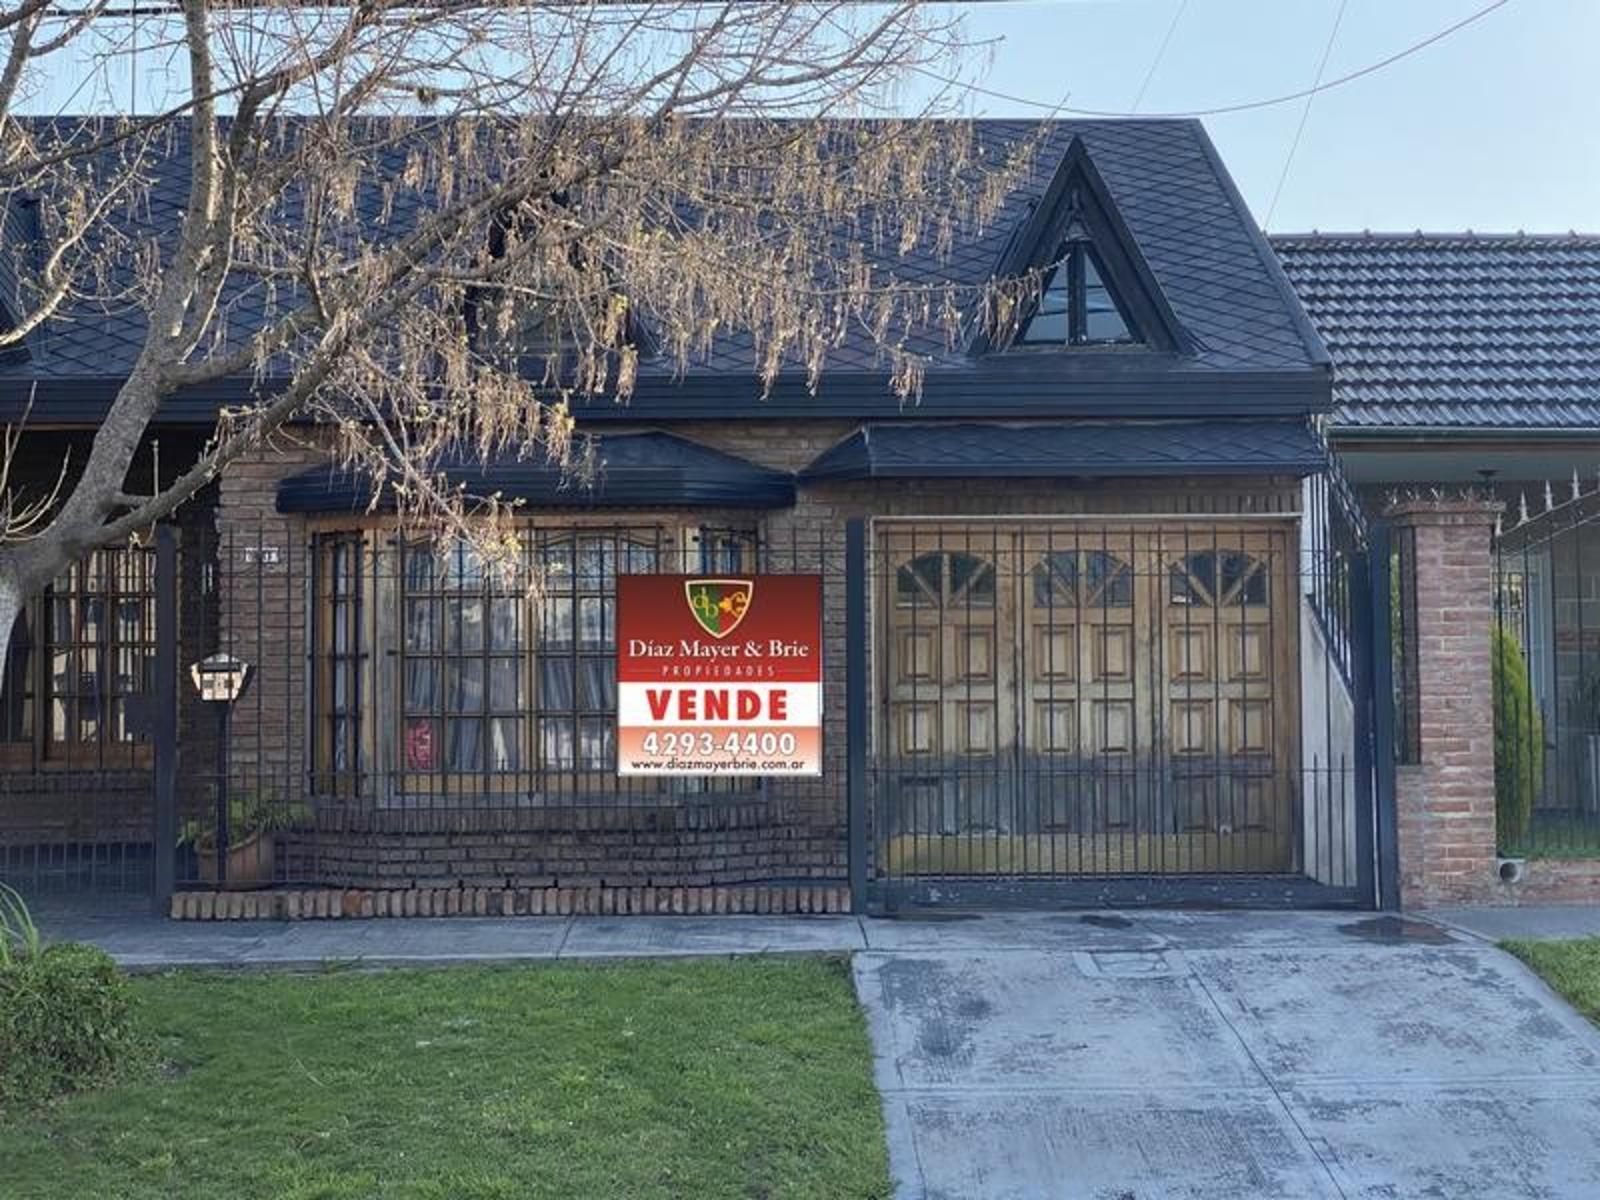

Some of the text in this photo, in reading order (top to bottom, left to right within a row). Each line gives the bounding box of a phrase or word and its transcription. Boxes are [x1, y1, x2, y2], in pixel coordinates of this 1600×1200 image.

[680, 639, 739, 662] Mayer
[744, 640, 762, 657] &
[769, 639, 809, 657] Brie
[662, 665, 776, 677] PROPIEDADES
[645, 689, 788, 721] VENDE
[643, 732, 796, 756] 4293-4400
[631, 758, 805, 772] www.diazmayerbrie.com.ar
